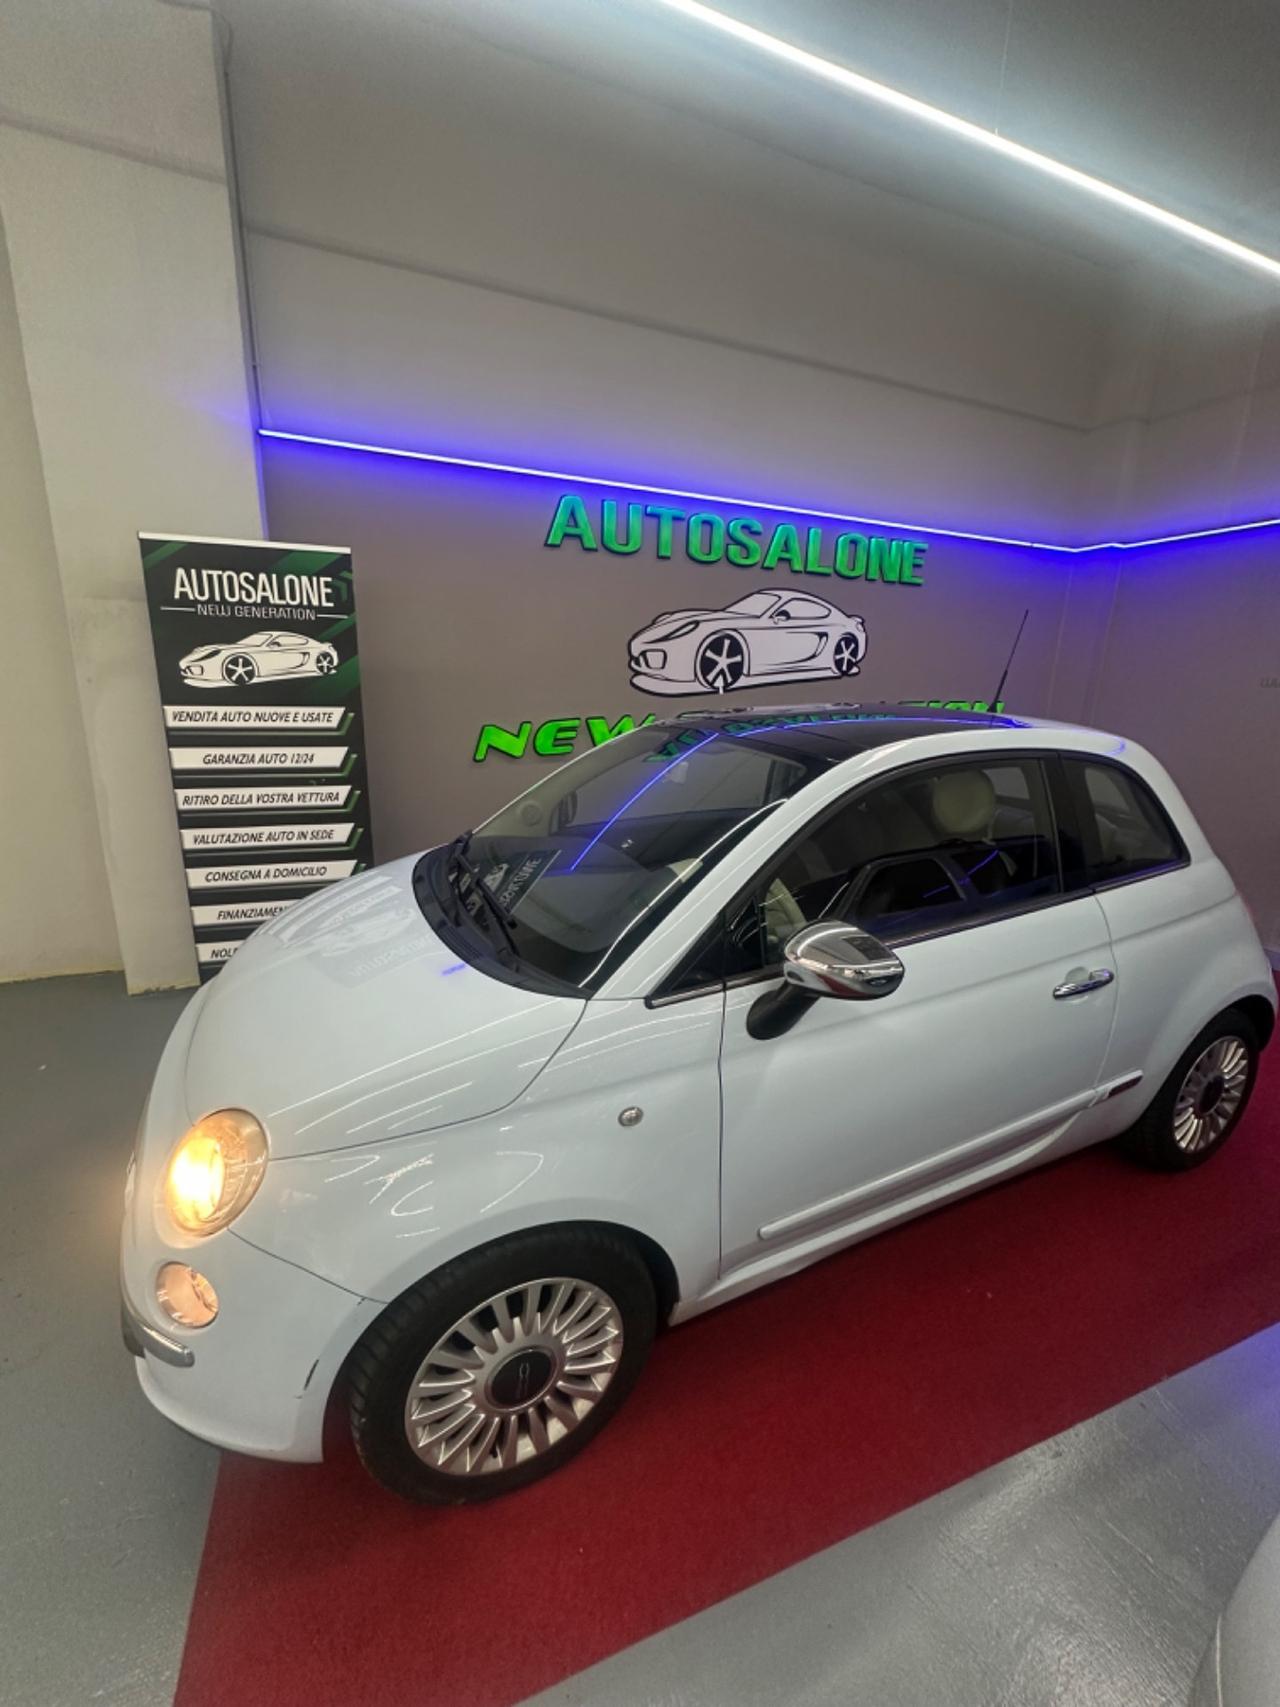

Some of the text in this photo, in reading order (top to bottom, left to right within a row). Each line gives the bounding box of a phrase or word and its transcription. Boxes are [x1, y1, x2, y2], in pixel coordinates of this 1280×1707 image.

[545, 494, 928, 586] AUTOSALONE
[174, 567, 334, 607] AUTOSALONE
[197, 604, 316, 621] NEW GENERATION
[172, 711, 334, 723] VENDITA AUTO NUOVE E USATE
[202, 753, 255, 765] GARANZIA
[257, 753, 288, 764] AUTO
[182, 792, 340, 806] RITIRO DELLA VOSTRA VETTURA
[193, 829, 334, 845] VALUTAZIONE AUTO IN SEDE
[204, 866, 328, 882] CONSEGNA A DOMICILIO
